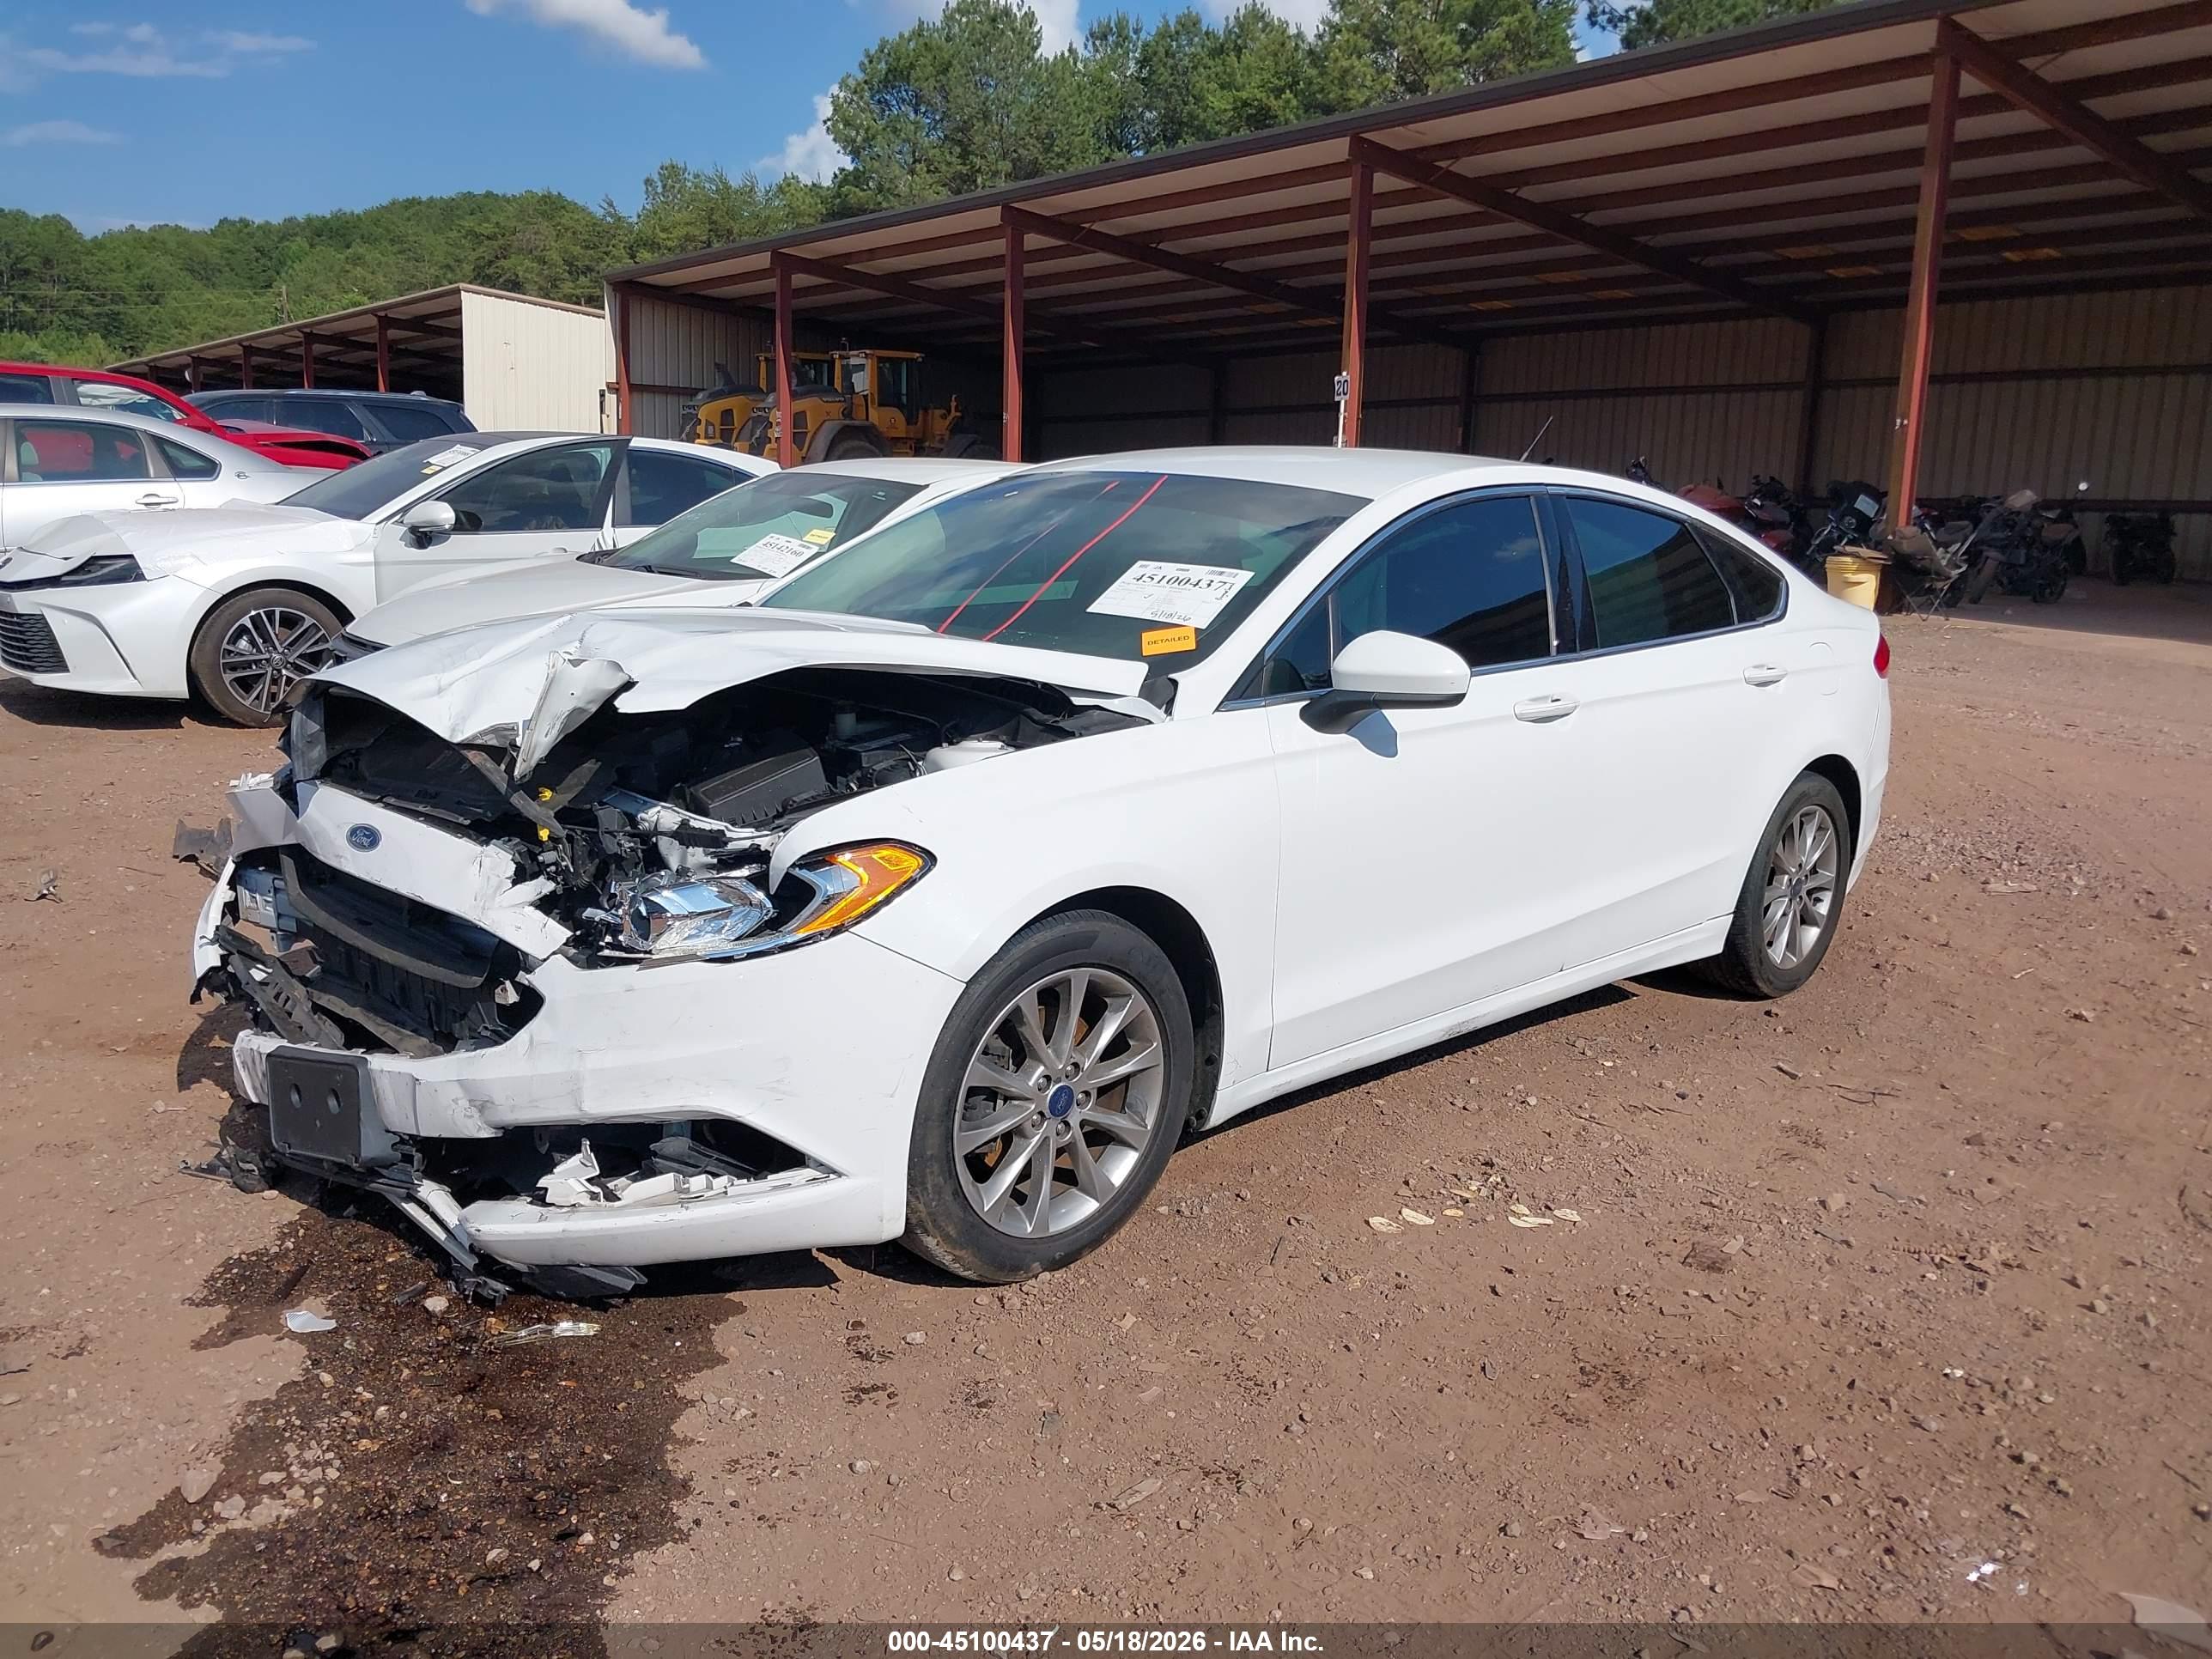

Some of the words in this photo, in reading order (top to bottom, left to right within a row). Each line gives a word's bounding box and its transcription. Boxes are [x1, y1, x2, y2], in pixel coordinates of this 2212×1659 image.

[1336, 380, 1349, 397] 20
[762, 541, 805, 557] 45142160
[1133, 573, 1227, 591] 45100437
[1147, 635, 1190, 646] DETAILED
[352, 829, 374, 848] Ford
